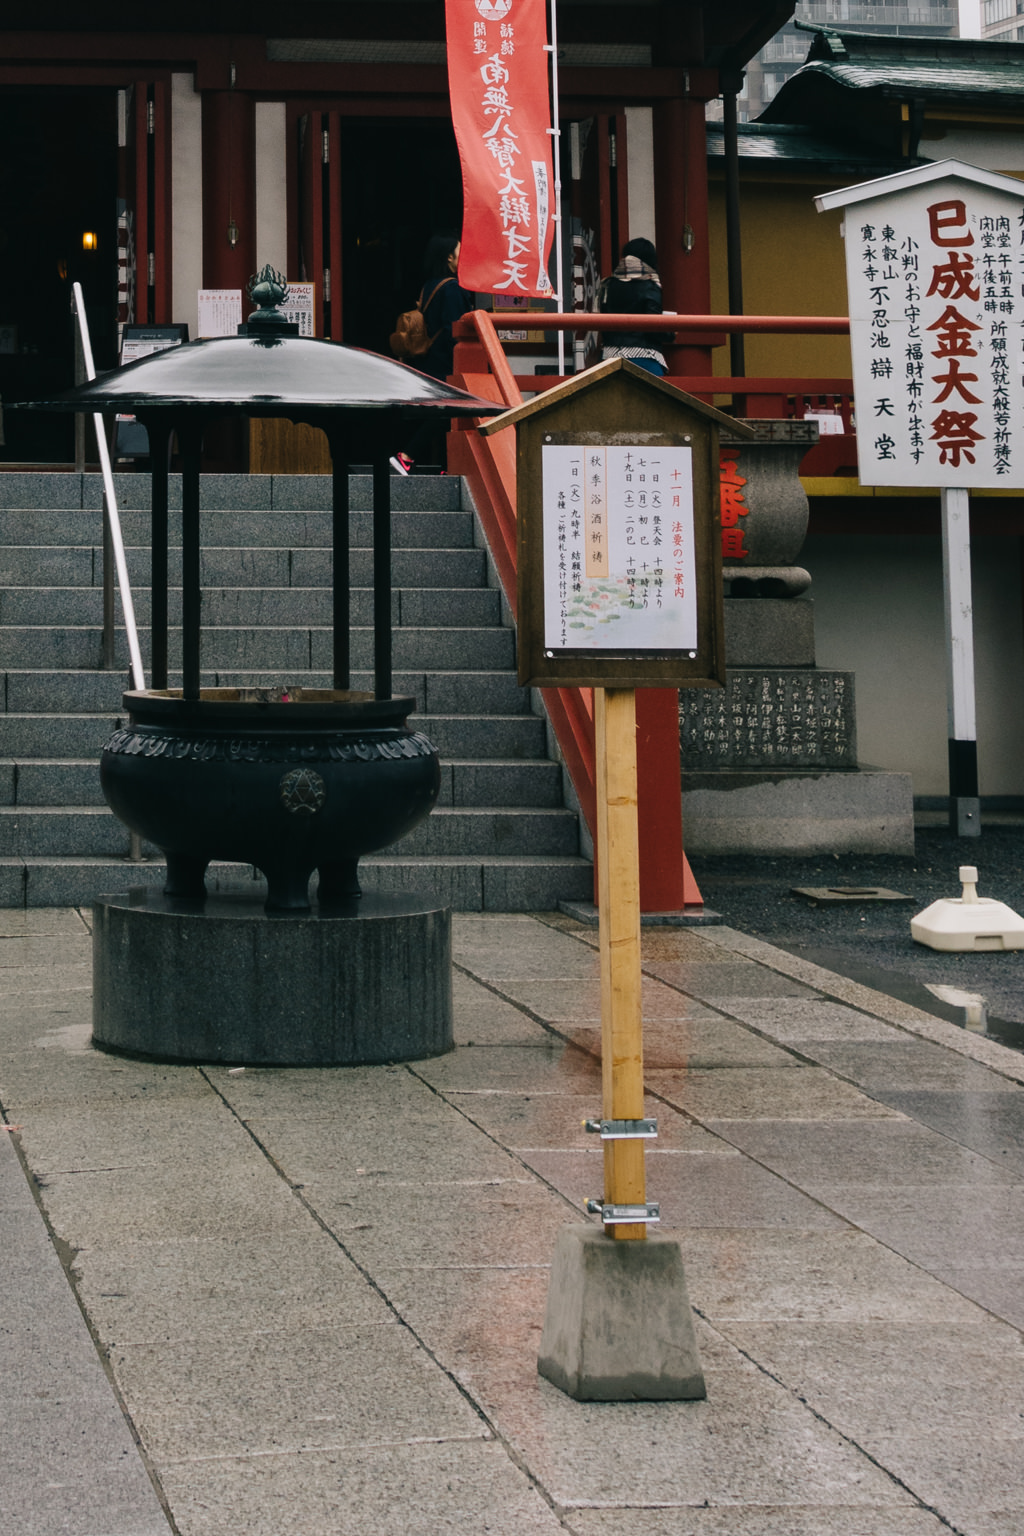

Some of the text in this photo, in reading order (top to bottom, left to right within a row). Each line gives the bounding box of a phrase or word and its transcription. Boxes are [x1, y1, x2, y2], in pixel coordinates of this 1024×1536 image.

[861, 224, 879, 281] 寛永寺
[882, 225, 899, 280] 東叡山
[926, 200, 986, 467] 巳成金大祭
[670, 469, 685, 598] 十一月 法要のご案内
